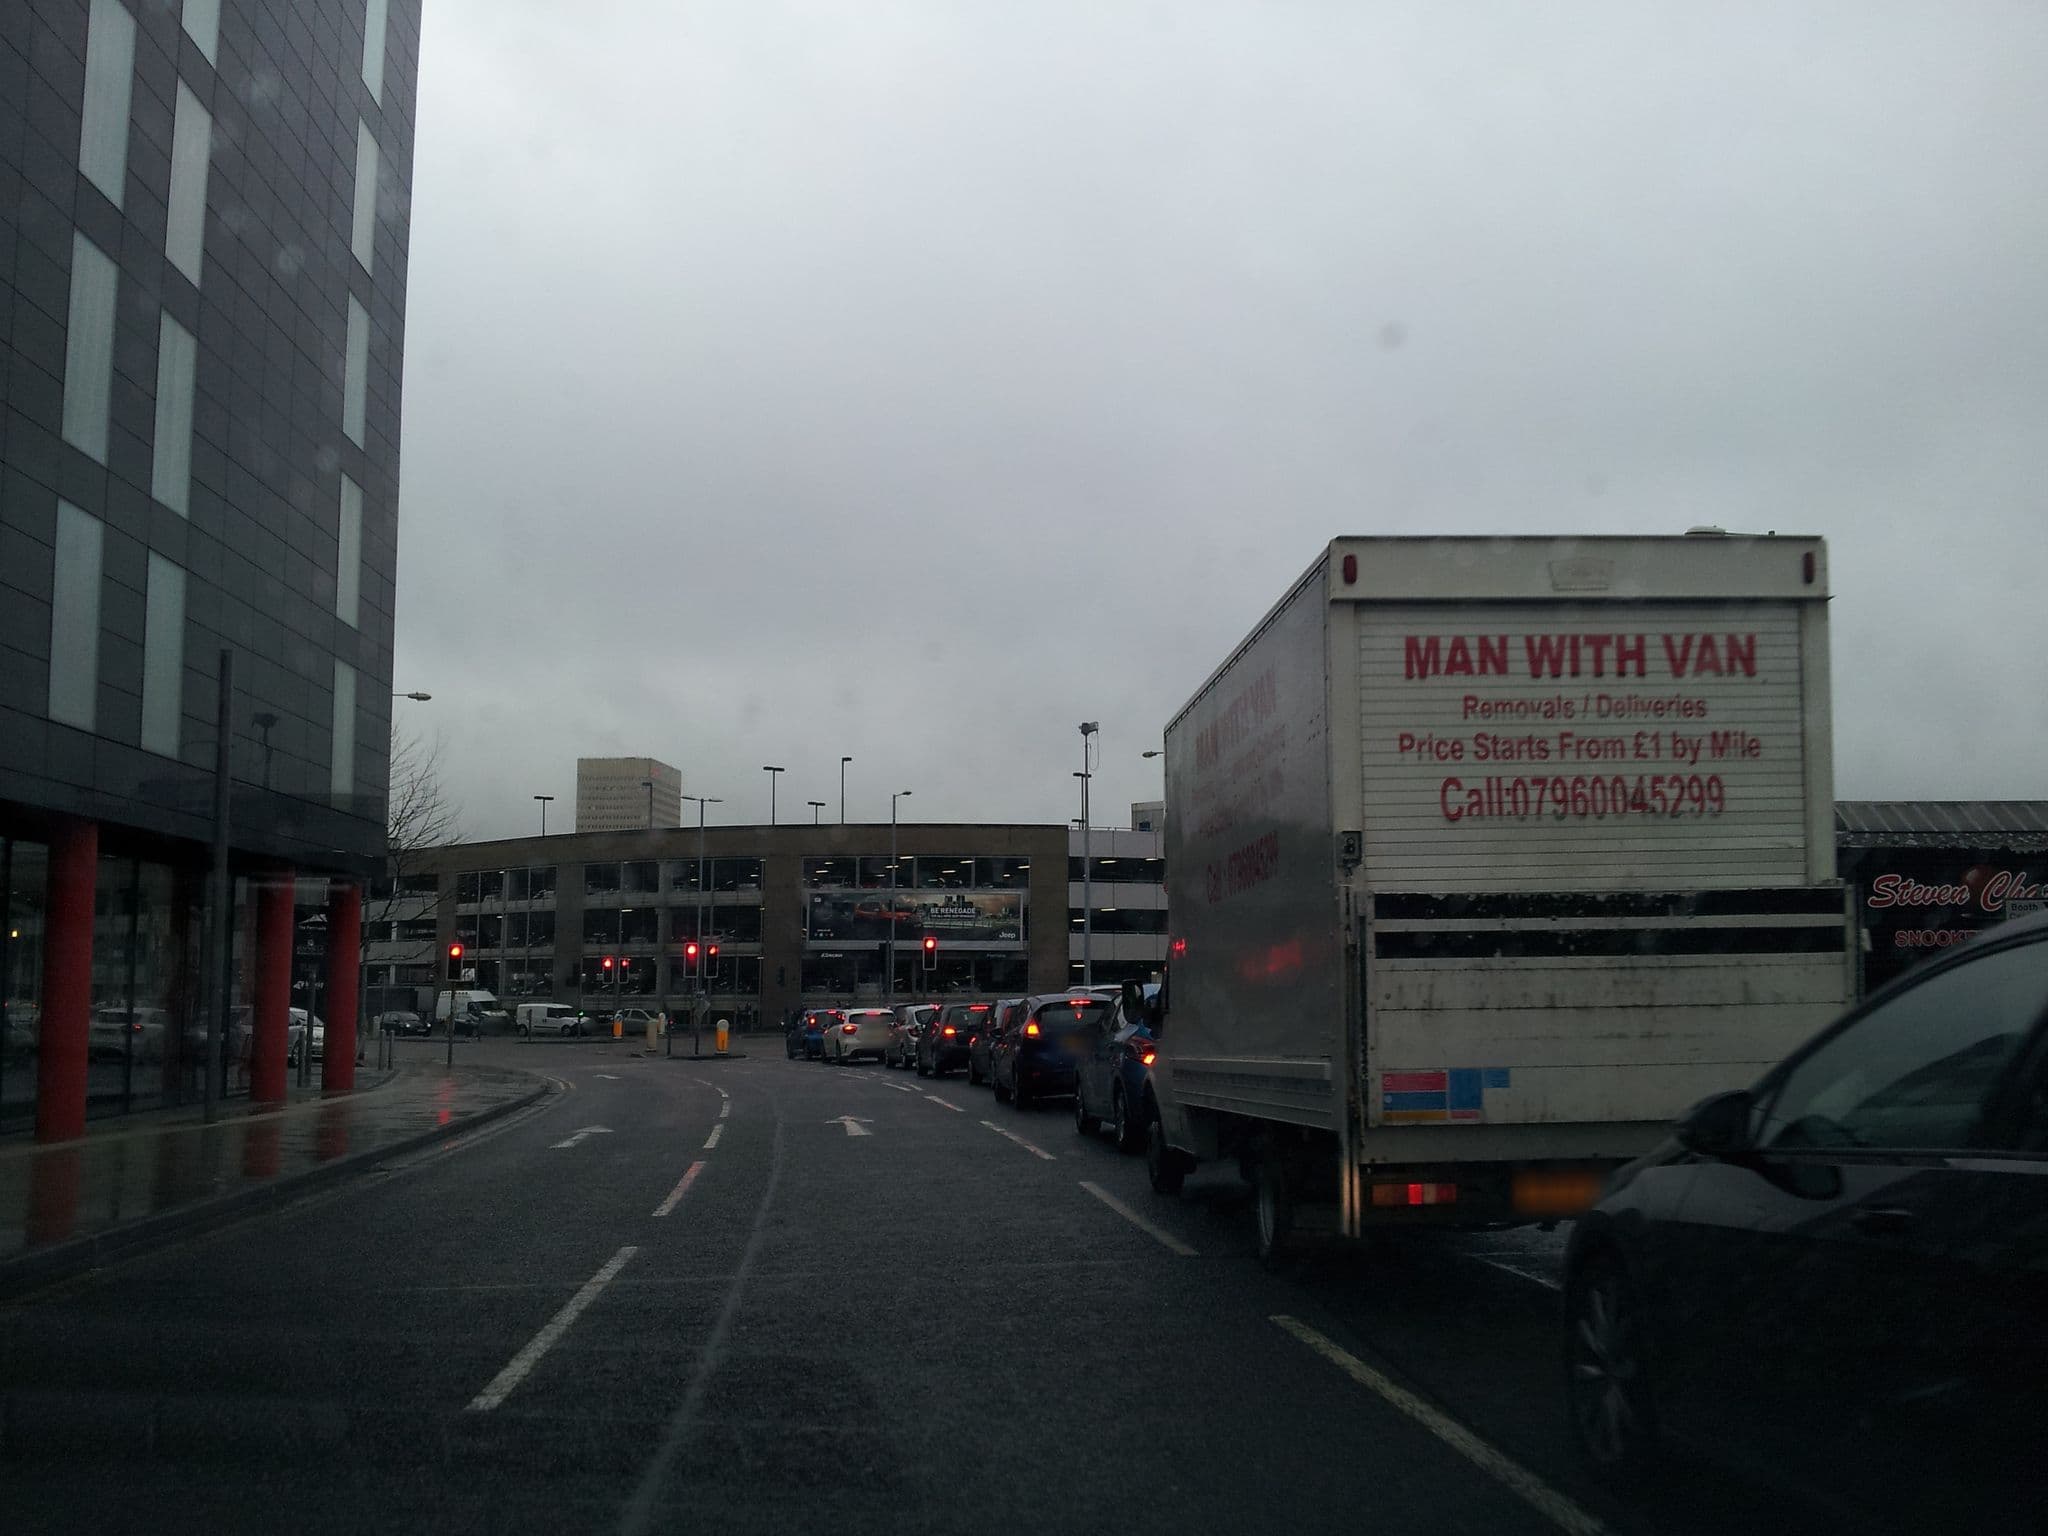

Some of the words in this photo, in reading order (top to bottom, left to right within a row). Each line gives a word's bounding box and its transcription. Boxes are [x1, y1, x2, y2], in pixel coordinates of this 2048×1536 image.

[1405, 635, 1508, 679] MAN
[1525, 634, 1646, 678] WITH
[1662, 633, 1757, 678] VAN
[1463, 695, 1575, 719] Removals
[1596, 693, 1707, 718] Deliveries
[1400, 733, 1464, 760] Price
[1473, 732, 1549, 760] Starts
[1559, 731, 1625, 760] From
[1633, 731, 1661, 759] £1
[1672, 731, 1702, 765] by
[1711, 730, 1761, 758] Mile
[1441, 775, 1724, 823] Call:07960045299
[1867, 873, 1970, 909] Steven
[999, 931, 1016, 939] Jeep
